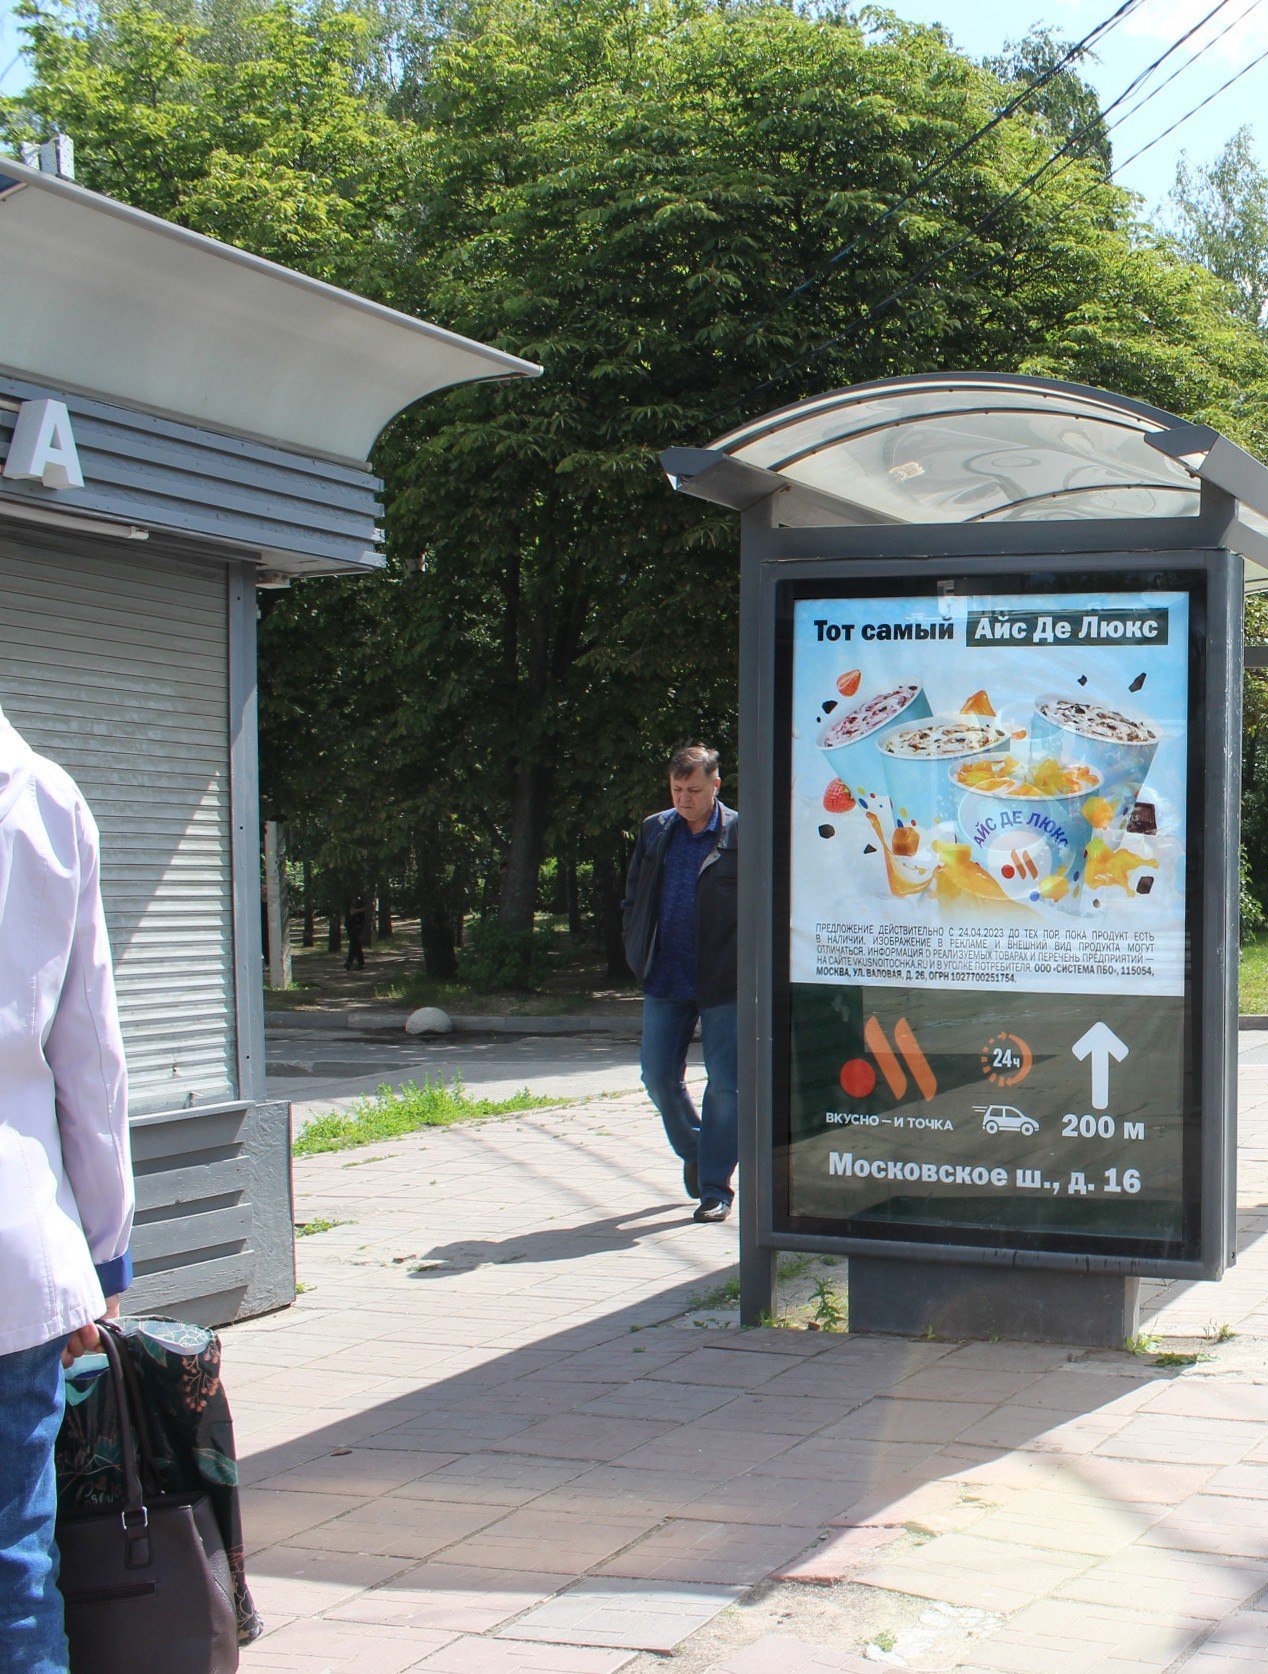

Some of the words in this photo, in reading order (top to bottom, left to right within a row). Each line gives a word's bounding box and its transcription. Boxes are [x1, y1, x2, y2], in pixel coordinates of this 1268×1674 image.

[814, 620, 855, 641] Тот
[860, 618, 954, 641] самый
[975, 615, 1027, 640] Айс
[1033, 618, 1071, 643] Де
[1079, 615, 1158, 639] Люкс
[974, 817, 997, 849] АЙС
[1000, 810, 1022, 828] ДЕ
[816, 923, 874, 934] ПРЕДЛОЖЕНИЕ
[878, 924, 944, 936] ДЕЙСТВИТЕЛЬНО
[949, 928, 953, 936] С
[959, 928, 1003, 938] 24.04.2023
[1009, 929, 1019, 939] ДО
[1025, 929, 1038, 938] ТЕХ
[1065, 930, 1087, 940] ПОКА
[1092, 931, 1129, 942] ПРОДУКТ
[1134, 932, 1155, 942] ЕСТЬ
[816, 934, 821, 943] В
[828, 935, 866, 945] НАЛИЧИИ.
[873, 937, 931, 947] ИЗОБРАЖЕНИЕ
[938, 938, 943, 947] В
[950, 939, 987, 949] РЕКЛАМЕ
[995, 940, 1000, 949] И
[1008, 940, 1048, 950] ВНЕШНИЙ
[1055, 942, 1071, 952] ВИД
[1079, 942, 1120, 952] ПРОДУКТА
[1128, 943, 1155, 953] МОГУТ
[817, 945, 866, 956] ОТЛИЧАТЬСЯ.
[868, 948, 923, 958] ИНФОРМАЦИЯ
[925, 949, 931, 958] О
[933, 949, 992, 960] РЕАЛИЗУЕМЫХ
[995, 951, 1029, 961] ТОВАРАХ
[1030, 952, 1035, 961] И
[1038, 952, 1080, 962] ПЕРЕЧЕНЬ
[1083, 953, 1143, 964] ПРЕДПРИЯТИЙ
[816, 967, 850, 978] МОСКВА,
[853, 968, 865, 977] УЛ.
[867, 968, 904, 979] ВАЛОВАЯ,
[906, 970, 913, 981] Д.
[915, 971, 927, 981] 26,
[929, 971, 949, 981] ОГРН
[951, 972, 1017, 983] 1027700251754.
[817, 956, 827, 965] НА
[828, 955, 851, 966] САЙТЕ
[854, 958, 928, 969] VKUSNOITOCHKA.RU
[930, 960, 935, 969] И
[937, 961, 942, 969] В
[944, 961, 973, 971] УГОЛКЕ
[974, 962, 1030, 972] ПОТРЕБИТЕЛЯ.
[1034, 964, 1051, 973] ООО
[1053, 964, 1095, 974] «СИСТЕМА
[1096, 965, 1119, 976] ПБО»,
[1121, 966, 1155, 976] 115054,
[993, 1048, 1020, 1068] 24ч
[825, 1112, 879, 1126] ВКУСНО
[894, 1115, 904, 1127] И
[907, 1117, 953, 1131] ТОЧКА
[1062, 1114, 1115, 1139] 200
[1123, 1121, 1145, 1140] м
[829, 1152, 1008, 1186] Московское
[1017, 1170, 1060, 1193] ш.,
[1068, 1172, 1095, 1194] д.
[1104, 1168, 1141, 1194] 16
